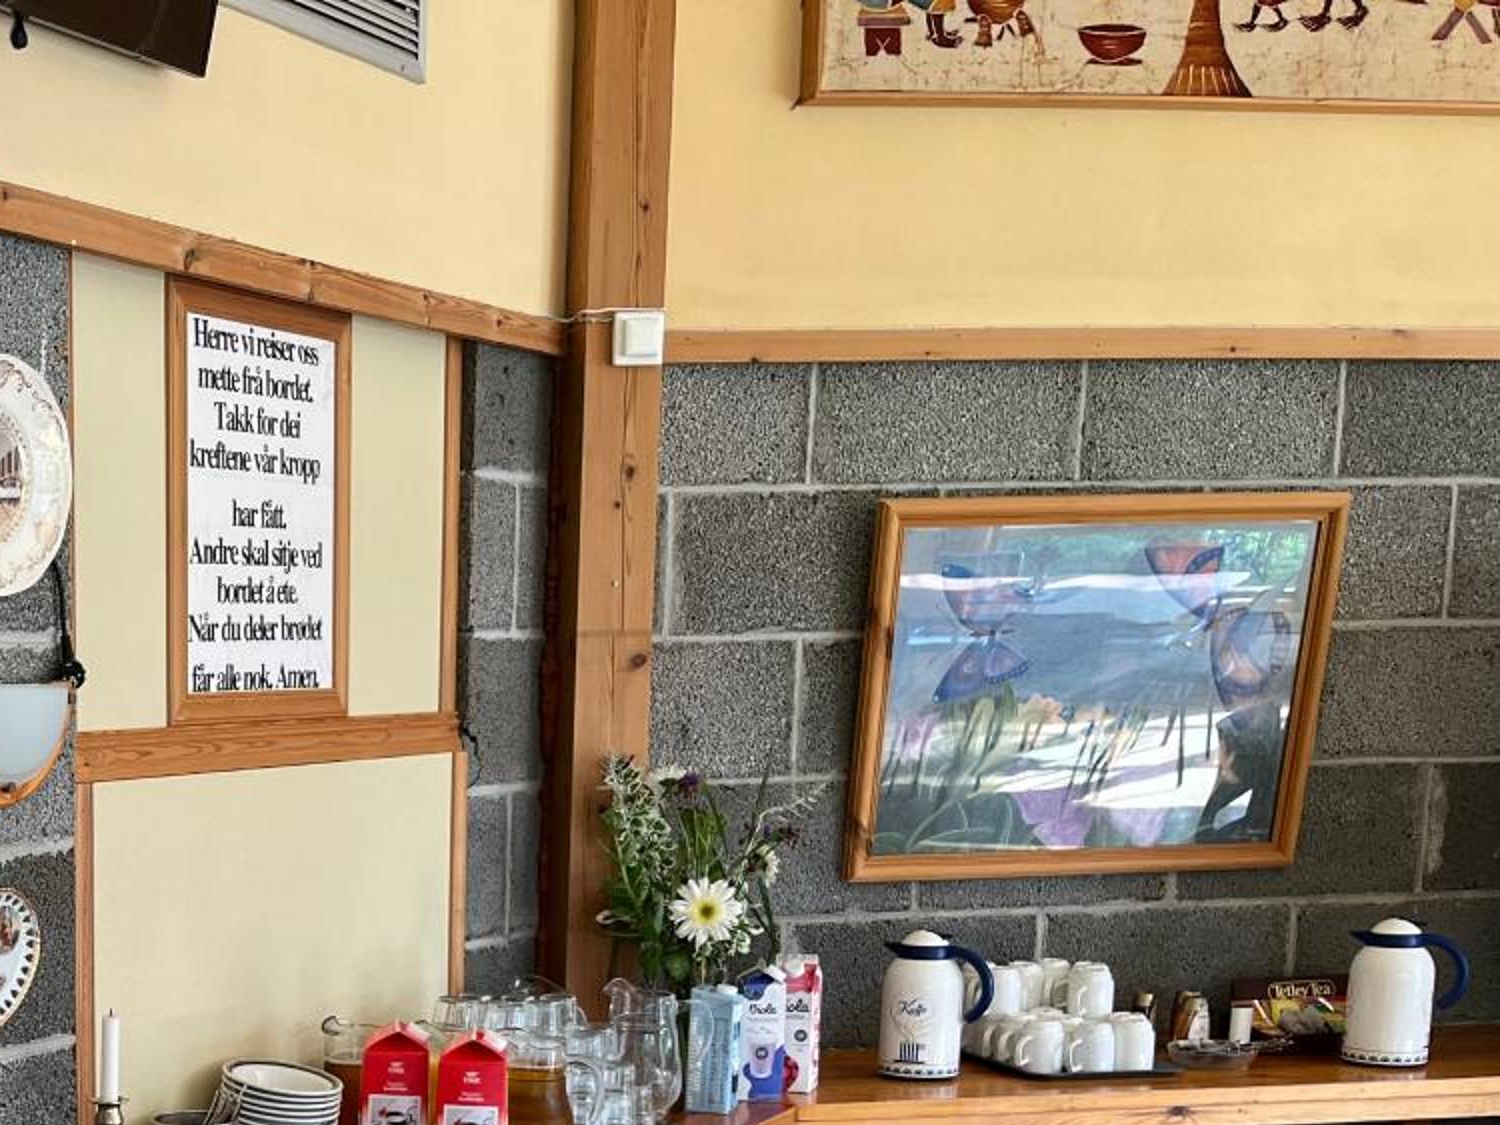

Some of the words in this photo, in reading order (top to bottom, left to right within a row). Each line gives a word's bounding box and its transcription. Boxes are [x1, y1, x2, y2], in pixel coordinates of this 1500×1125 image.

[194, 318, 239, 352] Herre
[242, 327, 254, 355] vi
[257, 331, 296, 362] reiser
[298, 346, 319, 366] oss
[199, 368, 240, 392] mette
[242, 366, 263, 396] frå
[266, 370, 313, 402] bordet.
[214, 402, 254, 433] Takk
[257, 408, 278, 435] for
[280, 411, 300, 438] dei
[254, 445, 278, 473] vår
[280, 448, 320, 484] kropp
[233, 500, 258, 527] har
[261, 500, 287, 529] fått.
[190, 537, 239, 565] Andre
[242, 539, 269, 566] skal
[301, 543, 322, 568] ved
[218, 576, 264, 604] bordet
[266, 576, 274, 604] å
[188, 614, 219, 643] Når
[222, 615, 241, 641] du
[244, 615, 278, 641] deler
[193, 664, 215, 692] får
[217, 665, 240, 691] alle
[244, 664, 273, 690] nok.
[276, 666, 319, 689] Amen.
